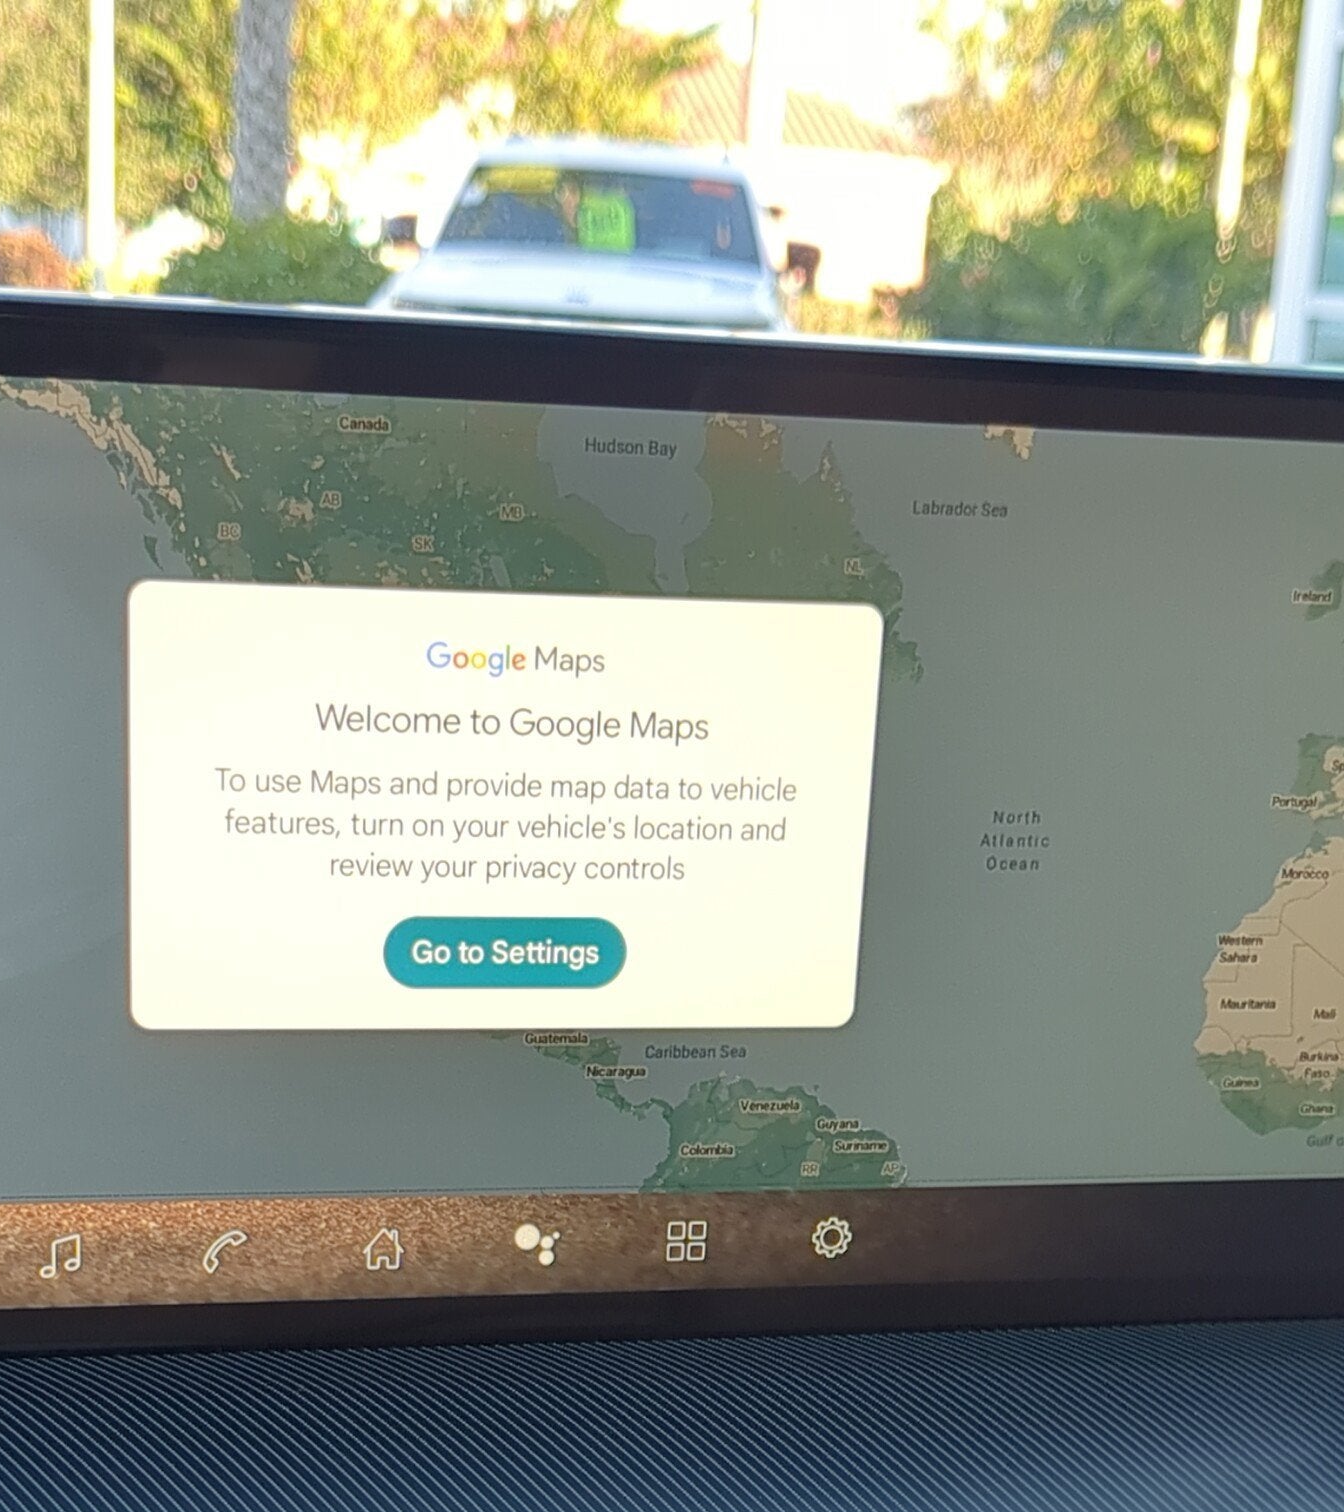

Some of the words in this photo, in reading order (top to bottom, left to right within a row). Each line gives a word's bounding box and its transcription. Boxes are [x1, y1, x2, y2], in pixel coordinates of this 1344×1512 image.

[338, 415, 391, 432] Canada
[584, 437, 644, 455] Hudson
[648, 440, 677, 460] Bay
[321, 492, 340, 506] AB
[501, 506, 523, 519] MB
[912, 500, 978, 517] Labrador
[981, 502, 1008, 518] Sea
[219, 523, 240, 538] BC
[413, 537, 433, 550] SK
[845, 560, 862, 573] NL
[1293, 589, 1332, 603] Ireland
[426, 641, 526, 678] Google
[534, 645, 606, 679] Maps
[315, 702, 461, 735] Welcome
[470, 709, 501, 735] to
[510, 708, 621, 746] Google
[630, 711, 709, 747] Maps
[214, 767, 246, 792] To
[255, 773, 302, 793] use
[310, 769, 382, 801] Maps
[389, 770, 438, 796] and
[446, 771, 542, 802] provide
[550, 778, 606, 805] map
[613, 774, 670, 800] data
[678, 777, 703, 800] to
[710, 775, 797, 801] vehicle
[1271, 796, 1318, 810] Portugal
[993, 810, 1042, 825] North
[225, 807, 341, 839] features,
[351, 813, 404, 836] turn
[412, 818, 445, 837] on
[452, 819, 509, 844] your
[517, 813, 626, 839] vehicle's
[633, 814, 733, 841] location
[740, 816, 787, 842] and
[979, 832, 1051, 848] Atlantic
[330, 851, 414, 877] review
[420, 859, 478, 884] your
[485, 853, 577, 885] privacy
[584, 855, 686, 880] controls
[985, 855, 1041, 871] Ocean
[1281, 867, 1330, 880] Morocco
[1218, 934, 1263, 947] Western
[411, 938, 451, 965] Go
[459, 940, 485, 965] to
[491, 938, 600, 971] Settings
[1219, 951, 1258, 964] Sahara
[1220, 998, 1276, 1011] Mauritania
[1313, 1008, 1337, 1020] Mali
[524, 1032, 589, 1045] Guatemala
[644, 1045, 717, 1060] Caribbean
[721, 1046, 747, 1060] Sea
[1299, 1050, 1339, 1063] Burkina
[586, 1065, 647, 1079] Nicaragua
[1303, 1067, 1331, 1079] Faso
[1222, 1076, 1260, 1090] Guinea
[741, 1099, 800, 1113] Venezuela
[1300, 1102, 1335, 1115] Ghana
[816, 1117, 860, 1132] Guyana
[679, 1144, 734, 1156] Colombia
[834, 1140, 888, 1153] Suriname
